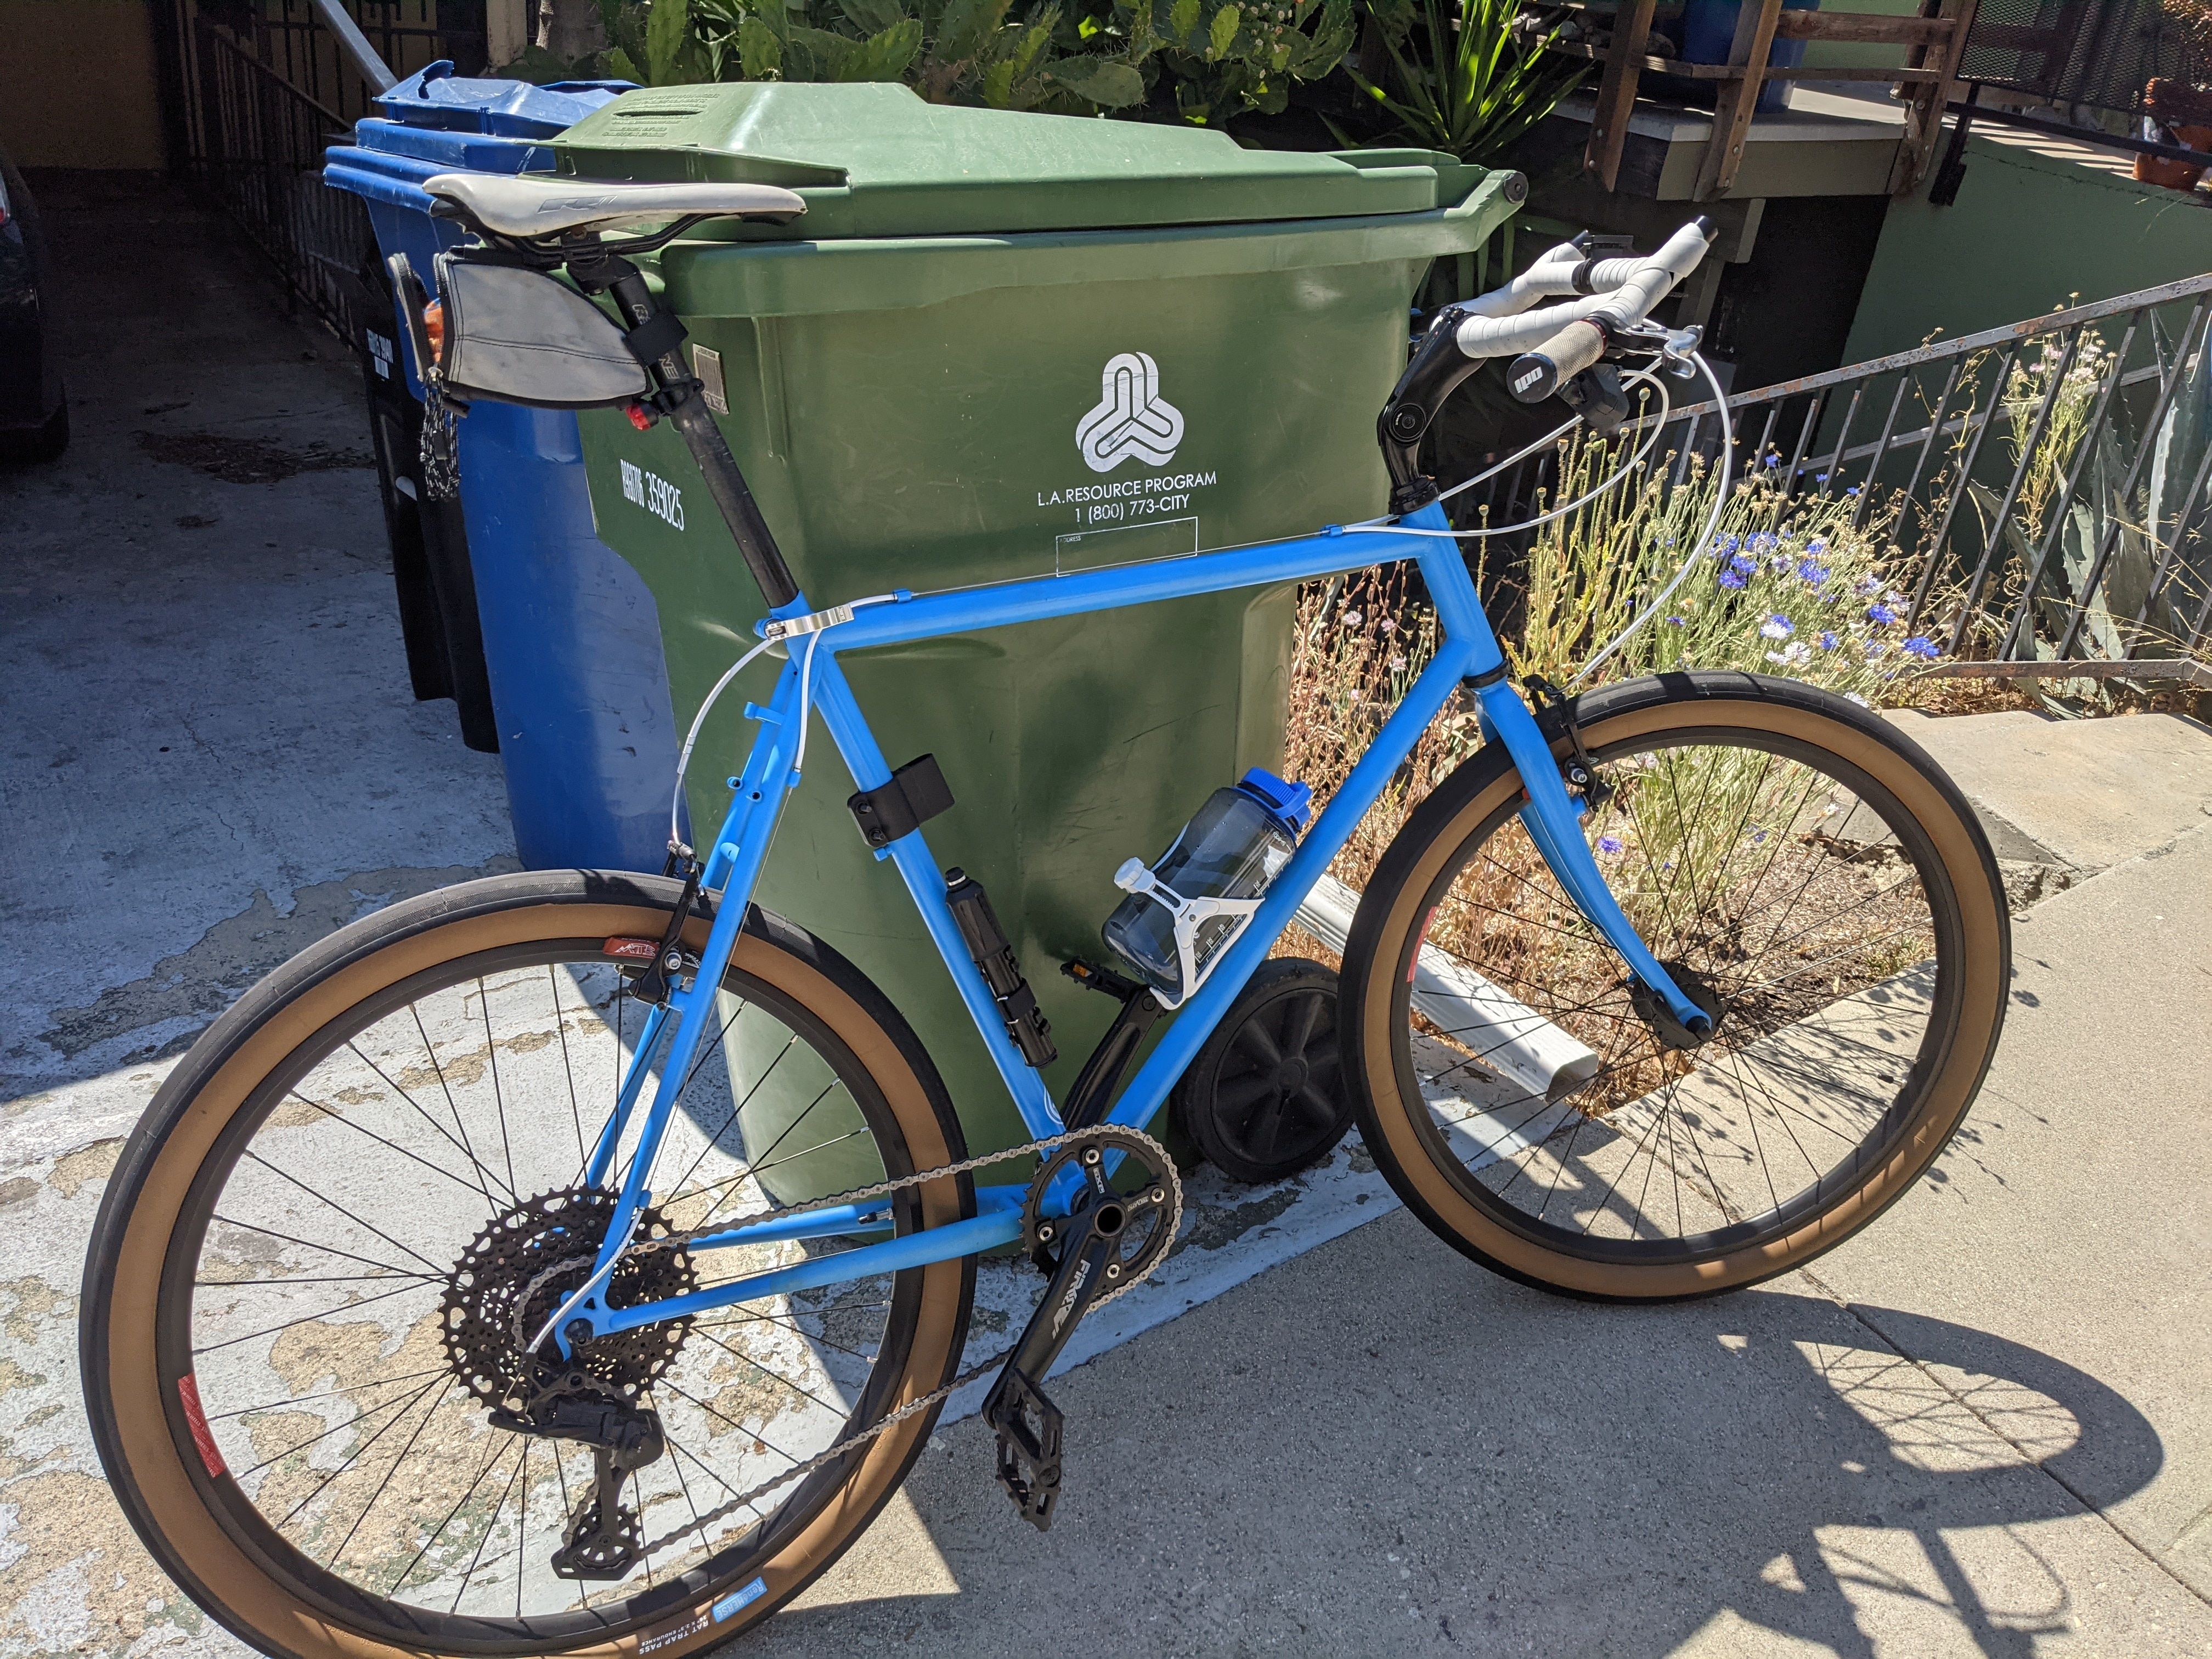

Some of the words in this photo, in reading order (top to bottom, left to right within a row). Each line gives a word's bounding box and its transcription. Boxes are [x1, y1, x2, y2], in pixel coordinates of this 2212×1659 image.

[1145, 471, 1217, 493] PROGRAM
[645, 471, 685, 531] 359025
[1075, 508, 1080, 523] 1
[1088, 502, 1124, 524] (800)
[1130, 494, 1190, 516] 773-CITY
[1059, 535, 1081, 543] ADDRESS
[614, 943, 656, 956] MTB
[692, 1620, 709, 1634] RAT
[641, 1629, 676, 1646] ENDURANCE
[665, 1632, 689, 1645] TRAP
[639, 1642, 662, 1655] PASS
